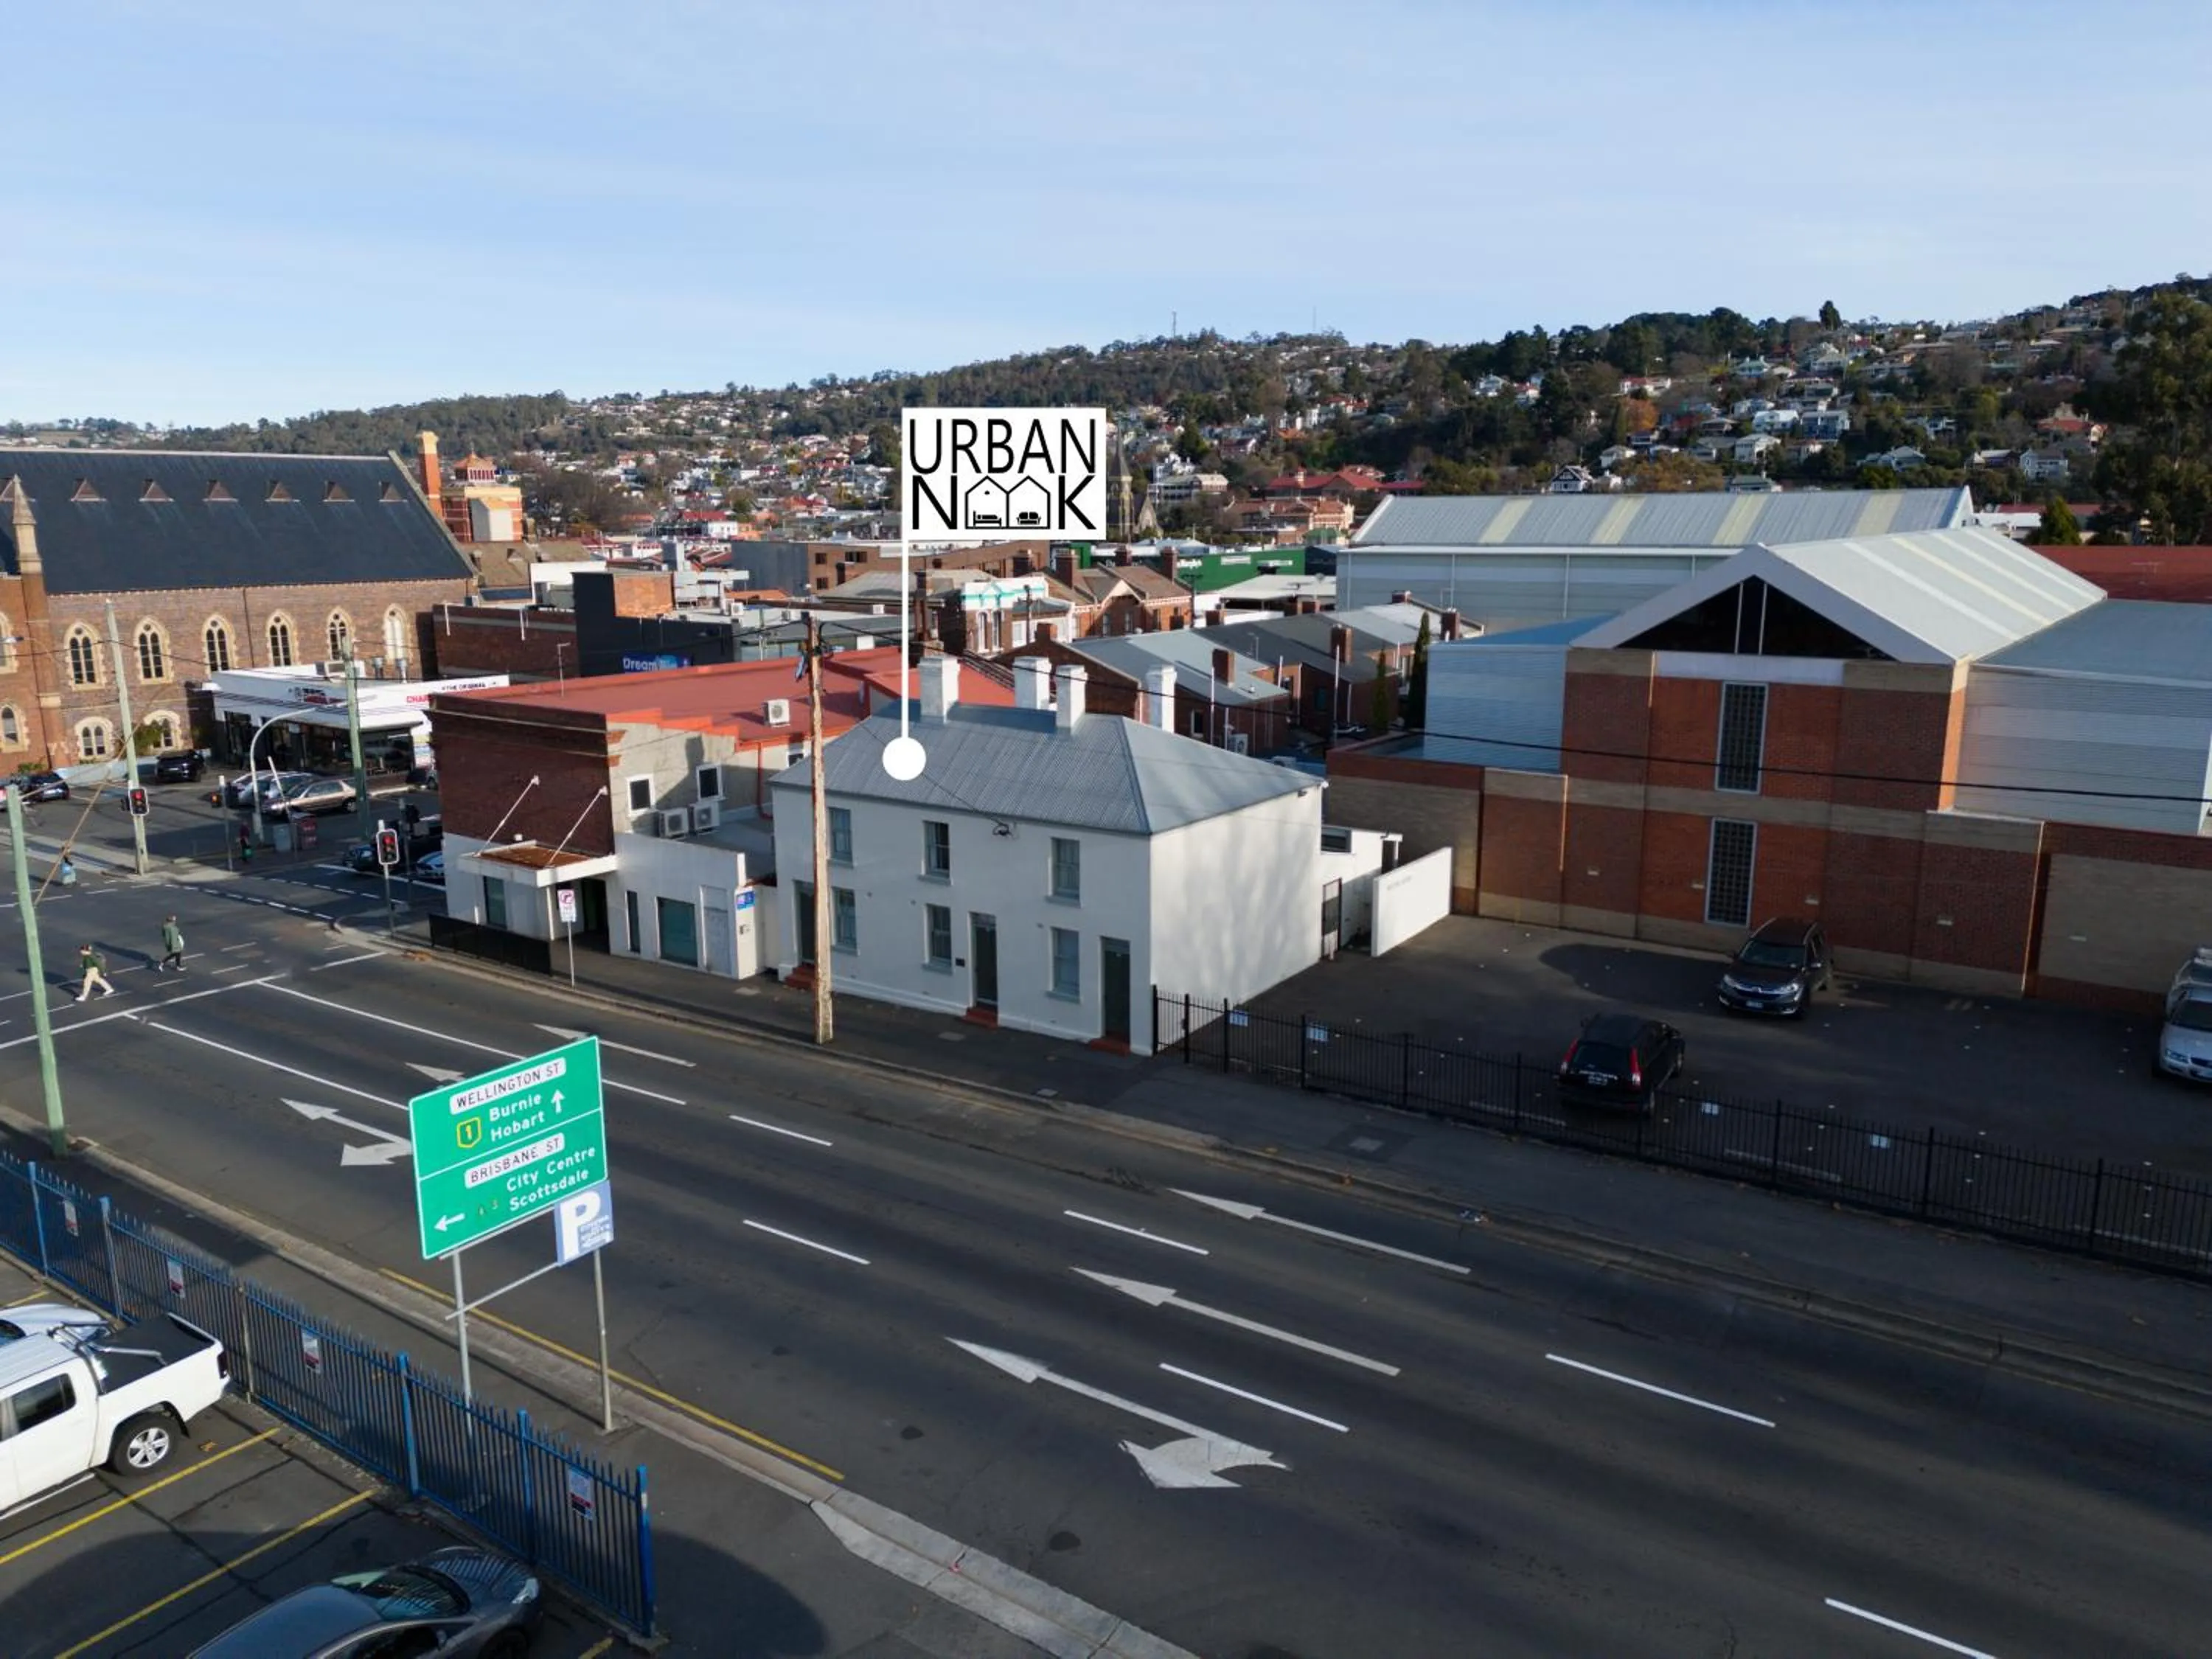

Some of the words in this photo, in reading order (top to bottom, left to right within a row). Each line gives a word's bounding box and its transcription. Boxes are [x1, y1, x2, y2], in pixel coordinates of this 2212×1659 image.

[456, 1070, 541, 1107] WELLINGTON
[546, 1062, 560, 1077] ST
[489, 1094, 542, 1121] Burnie
[490, 1111, 545, 1141] Hobart
[471, 1147, 539, 1183] BRISBANE
[546, 1138, 559, 1152] ST
[507, 1170, 538, 1192] City
[546, 1147, 596, 1174] Centre
[509, 1169, 589, 1211] Scottsdale
[560, 1192, 601, 1262] P
